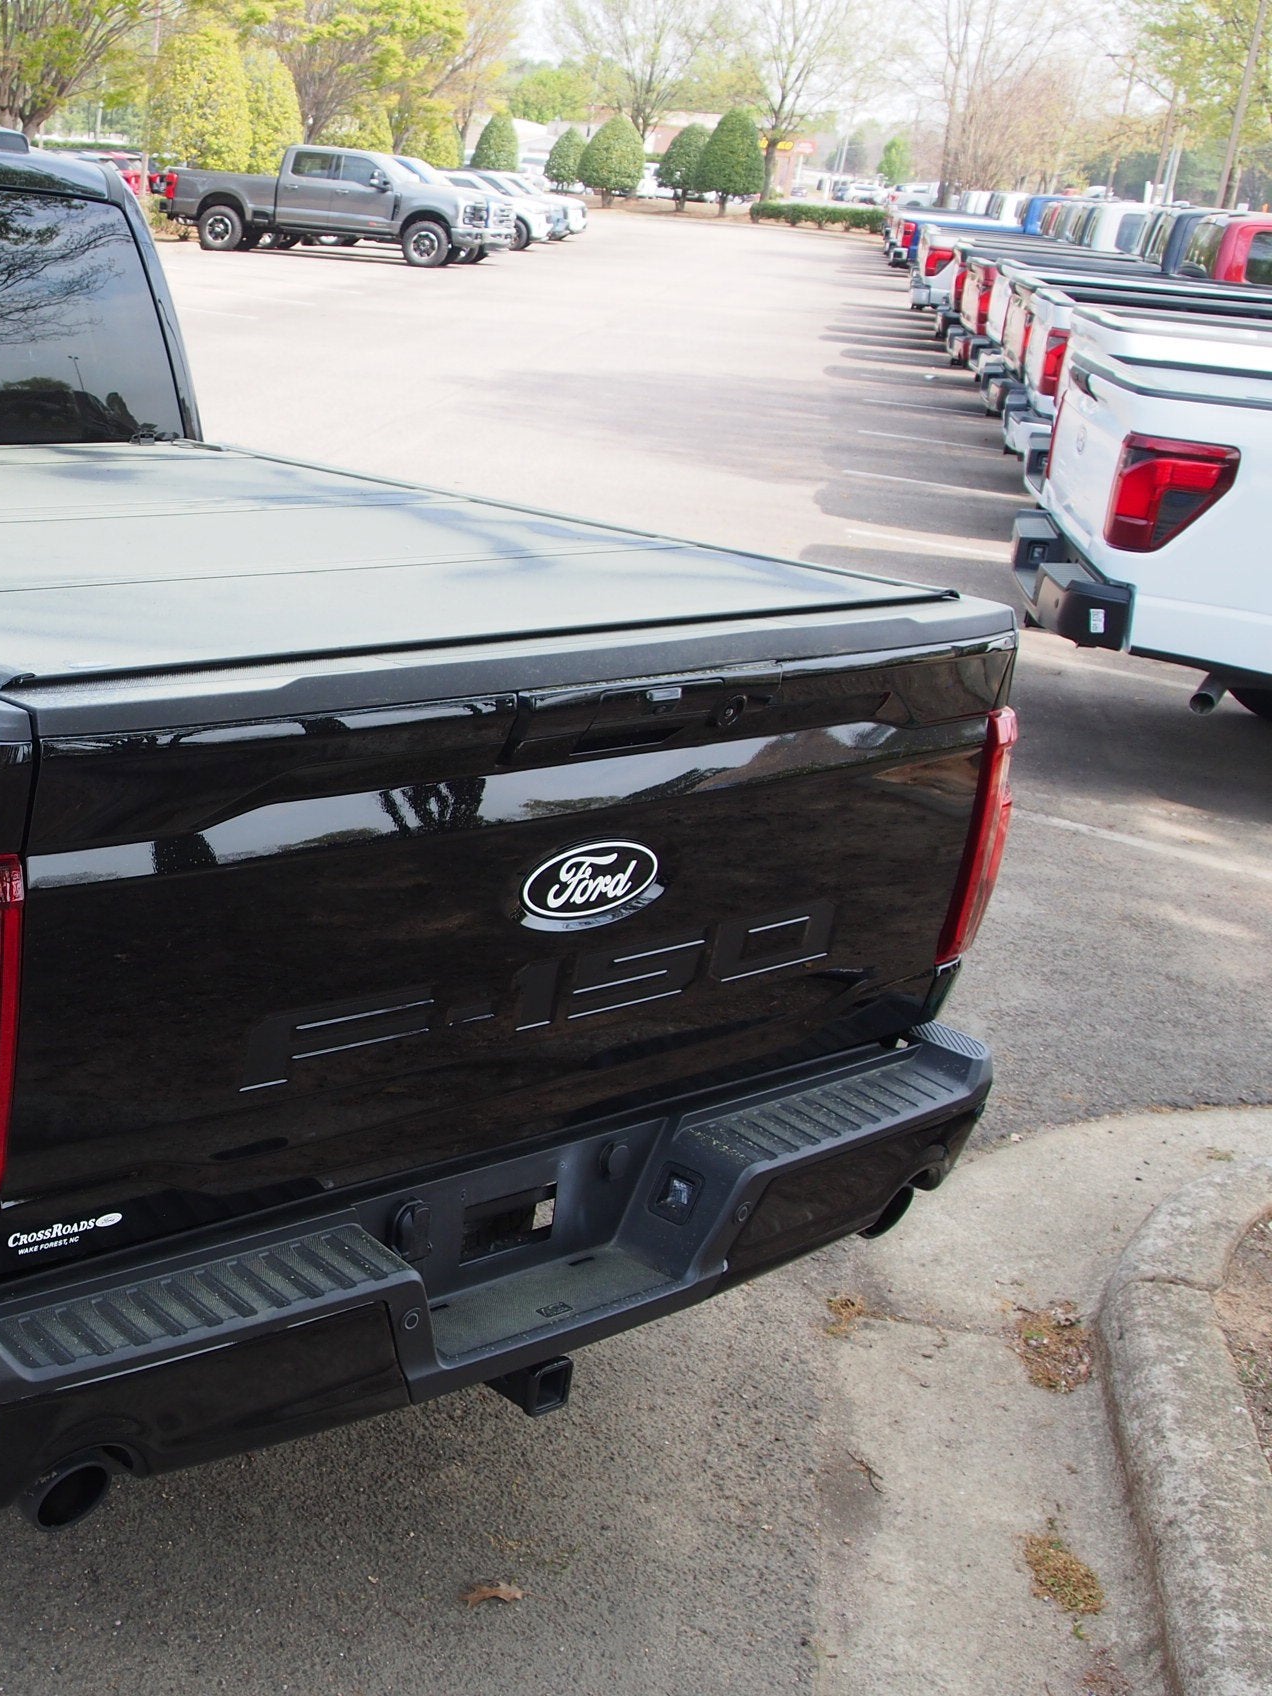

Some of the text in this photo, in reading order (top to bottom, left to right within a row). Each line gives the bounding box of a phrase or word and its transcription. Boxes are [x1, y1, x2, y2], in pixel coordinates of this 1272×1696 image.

[547, 853, 637, 908] Ford
[239, 900, 835, 1092] F-150
[18, 1245, 38, 1255] WAKE
[40, 1238, 68, 1250] FOREST,
